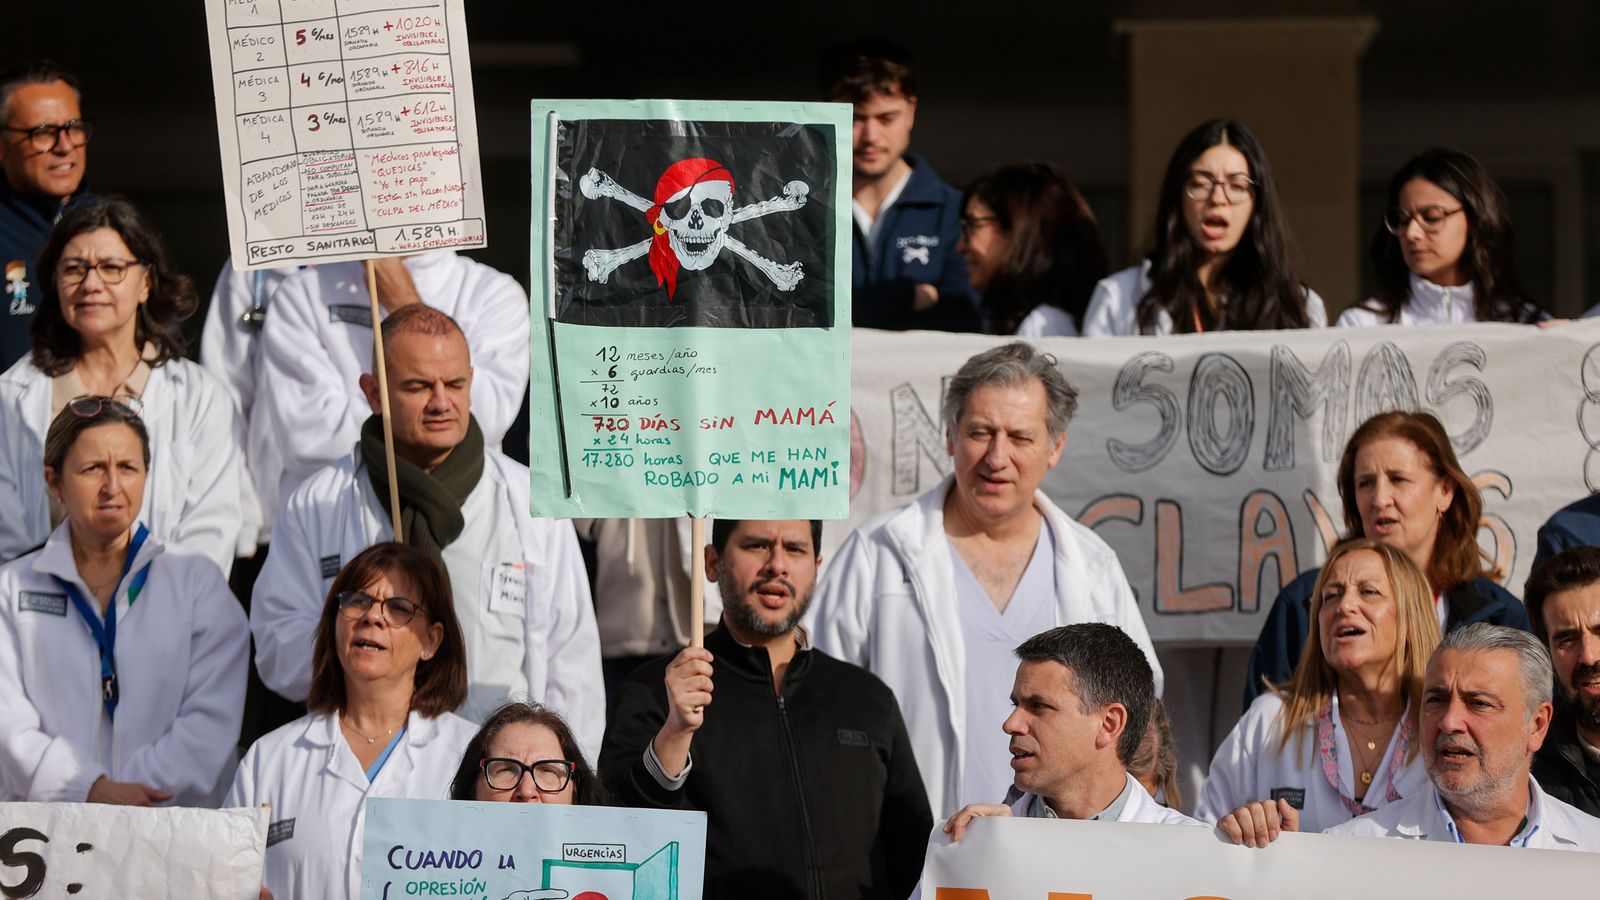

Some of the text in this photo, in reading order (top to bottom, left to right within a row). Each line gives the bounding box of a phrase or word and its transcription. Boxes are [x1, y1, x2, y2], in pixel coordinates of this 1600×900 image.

[233, 33, 275, 50] MÉDICO
[296, 29, 306, 45] 5
[395, 32, 437, 42] INVISIBLES
[256, 52, 265, 61] 2
[239, 75, 280, 88] MÉDICA
[300, 73, 311, 87] 4
[402, 76, 447, 86] INVISIBLES
[258, 91, 267, 102] 3
[243, 115, 285, 126] MÉDICA
[307, 114, 320, 132] 3
[410, 115, 453, 128] INVISIBLES
[261, 131, 271, 143] 4
[247, 160, 297, 186] ABANDONO
[395, 177, 404, 186] te
[249, 177, 289, 204] DE LOS
[406, 191, 417, 199] sin
[408, 205, 425, 213] DEL
[395, 225, 444, 242] 1.589
[250, 236, 374, 259] RESTO SANITARIOS
[595, 346, 621, 363] 12
[607, 364, 618, 379] 6
[601, 383, 619, 395] 72
[628, 394, 658, 407] años
[592, 415, 630, 433] 720
[638, 413, 681, 431] DÍAS
[754, 400, 837, 426] MAMÁ
[607, 433, 629, 446] 24
[635, 433, 671, 446] horas
[581, 447, 828, 468] 17.280 horas QUE ME HAN
[644, 470, 719, 487] ROBADO
[732, 472, 744, 485] A
[387, 844, 516, 870] CUANDO LA
